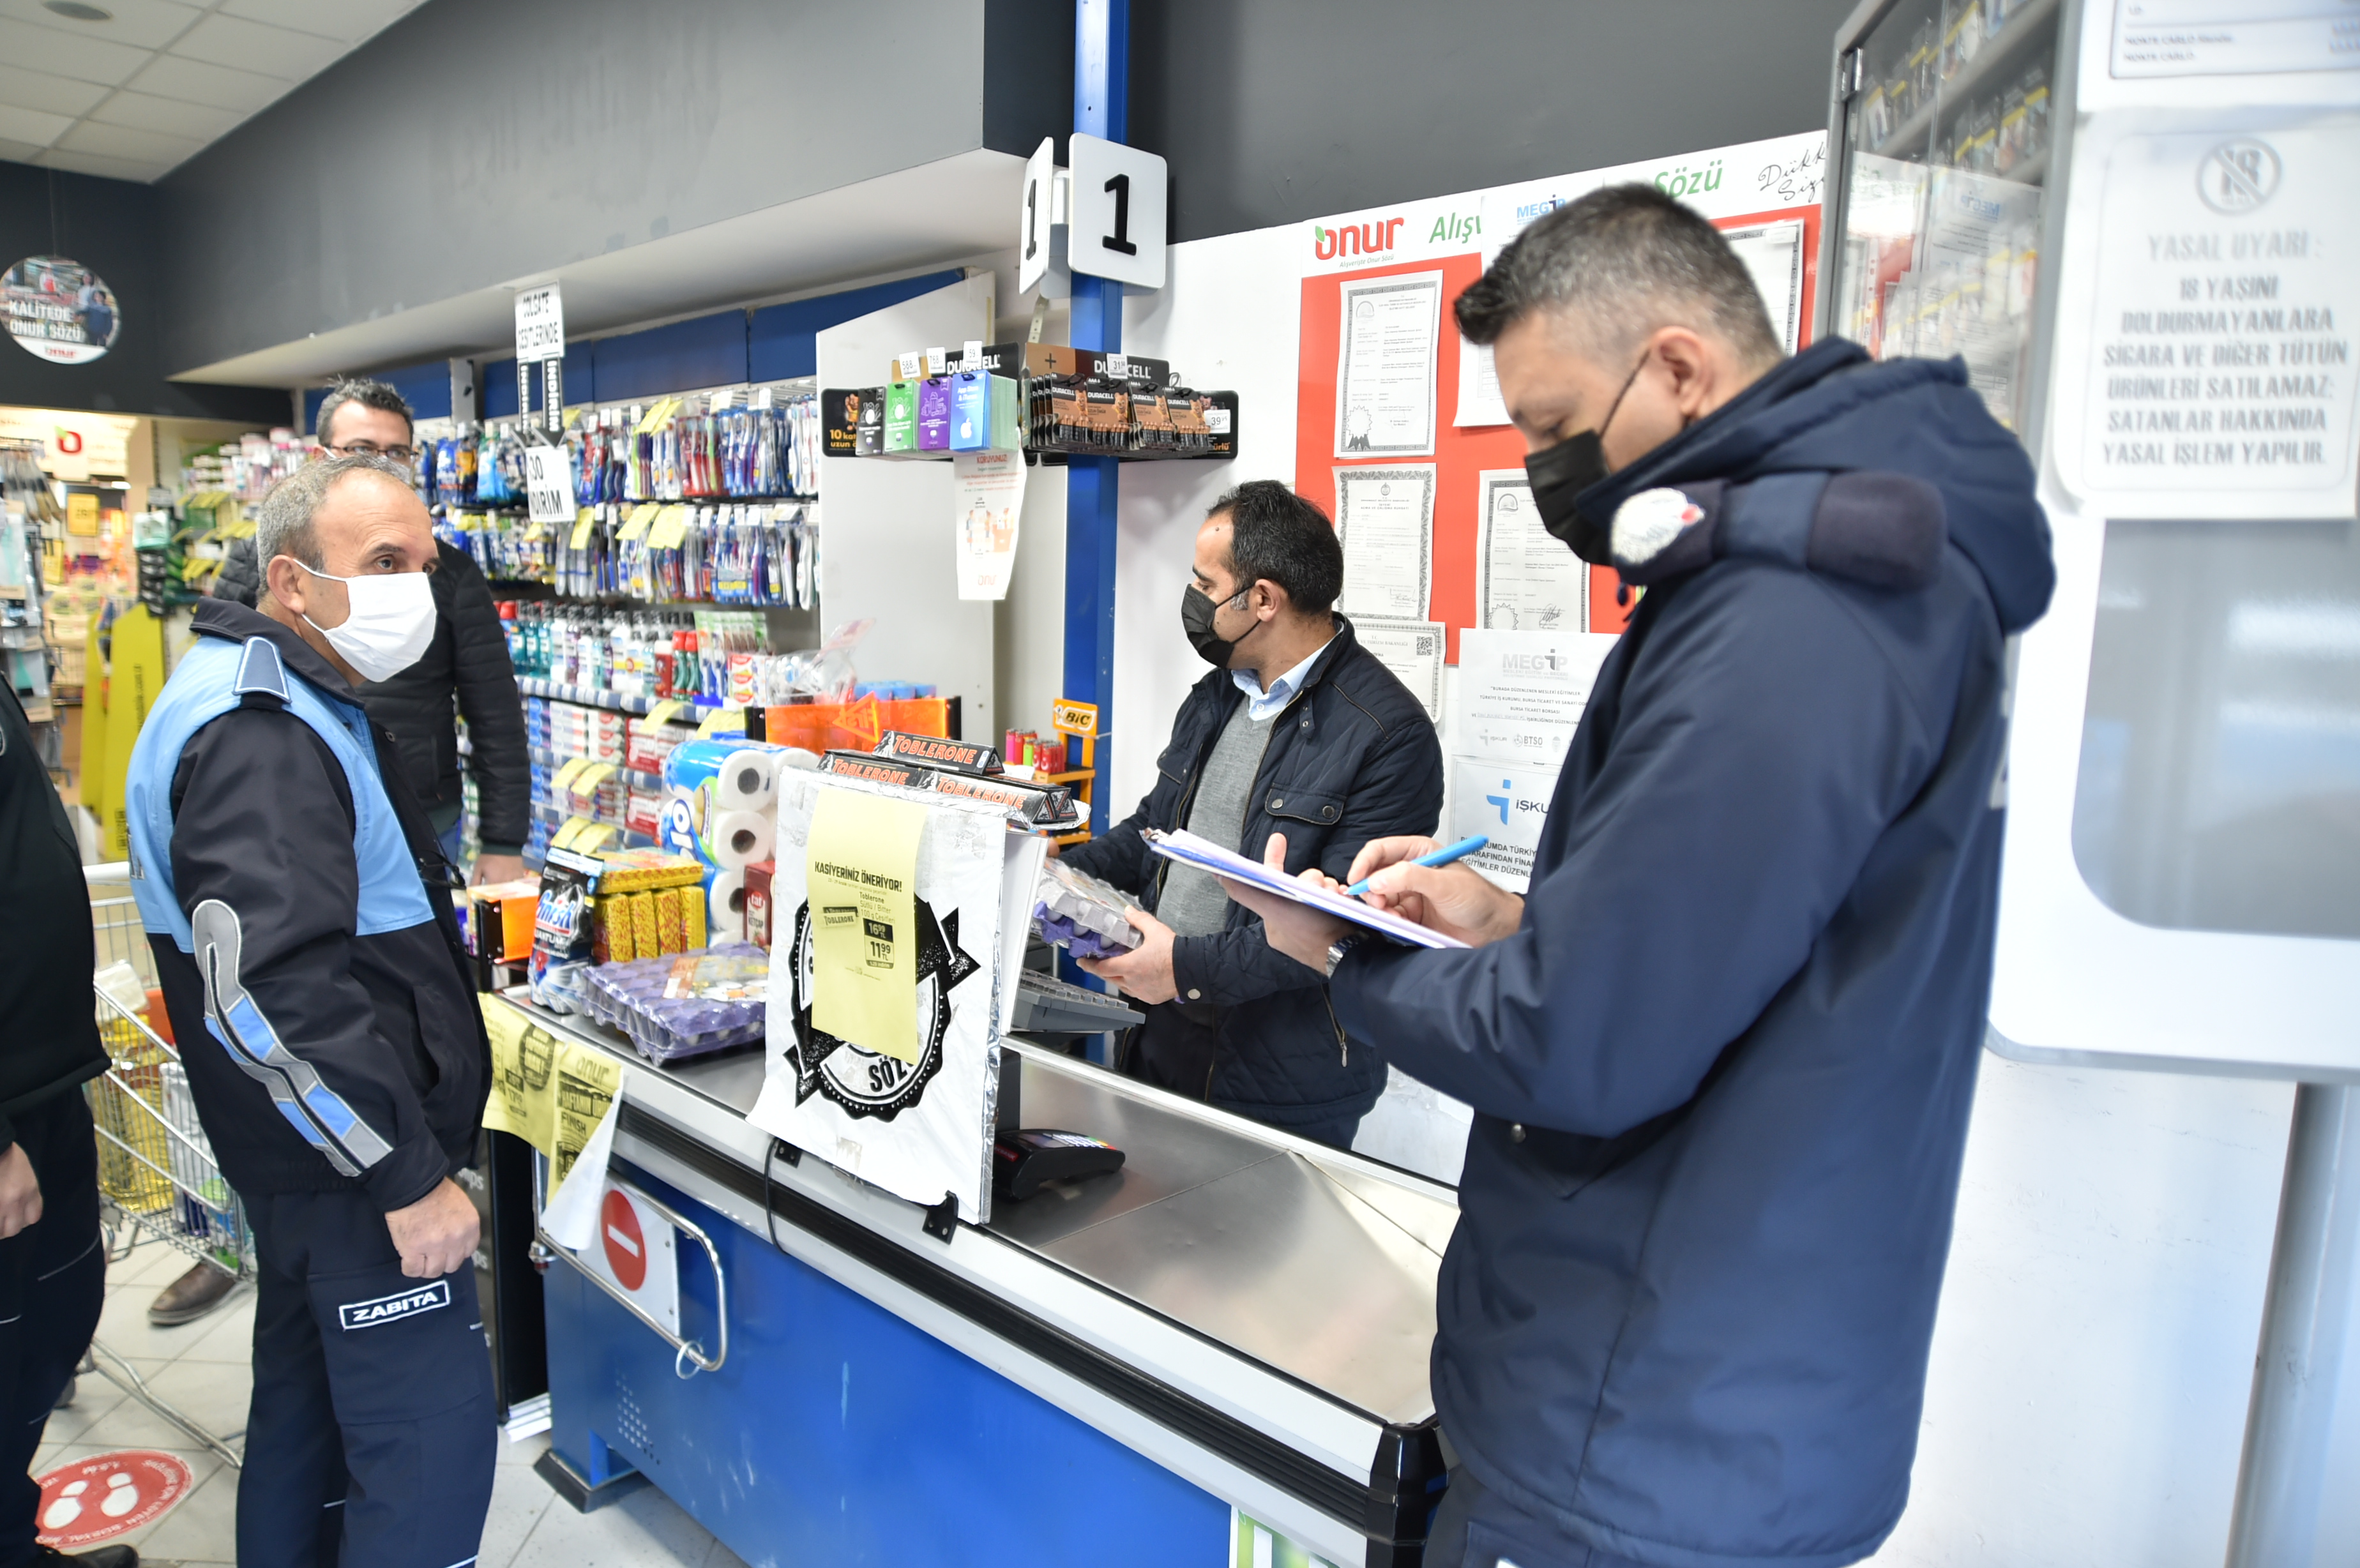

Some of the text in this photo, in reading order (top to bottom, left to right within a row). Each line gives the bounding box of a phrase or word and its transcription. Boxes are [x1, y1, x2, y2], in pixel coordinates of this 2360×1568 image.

[1655, 160, 1723, 198] Sözü
[1026, 173, 1137, 260] 1 1
[2148, 228, 2309, 261] YASAL UYARI
[1339, 253, 1394, 268] Alışverişte Onur Sözü
[2180, 275, 2279, 302] 18 YAŞINI
[9, 299, 73, 322] KALİTEDE
[2121, 306, 2333, 335] DOLDURMAYANLARA
[10, 319, 81, 341] ONUR SÖZÜ
[2105, 337, 2347, 367] SİGARA VE DİĞER TÜTÜN
[1052, 387, 1075, 395] DURACELL
[2107, 372, 2200, 400] ÜRÜNLERİ
[1211, 417, 1221, 425] 39
[2108, 408, 2326, 433] SATANLAR HAKKINDA
[829, 429, 842, 440] 10
[2103, 442, 2165, 465] YASAL
[2173, 437, 2234, 467] İŞLEM
[892, 734, 978, 764] TOBLERONE
[1524, 735, 1543, 746] BTSO
[832, 759, 910, 785] TOBLERONE
[935, 776, 1028, 810] TOBLERONE
[815, 861, 903, 893] KASİYERİNİZ ÖNERİYOR!
[859, 892, 884, 904] Toblerone
[860, 900, 874, 909] Sütlü
[877, 903, 891, 914] Bitter
[824, 916, 854, 926] TOBLERONE
[861, 908, 870, 917] 100
[868, 1056, 916, 1092] SÖZ
[352, 1291, 438, 1322] ZABITA
